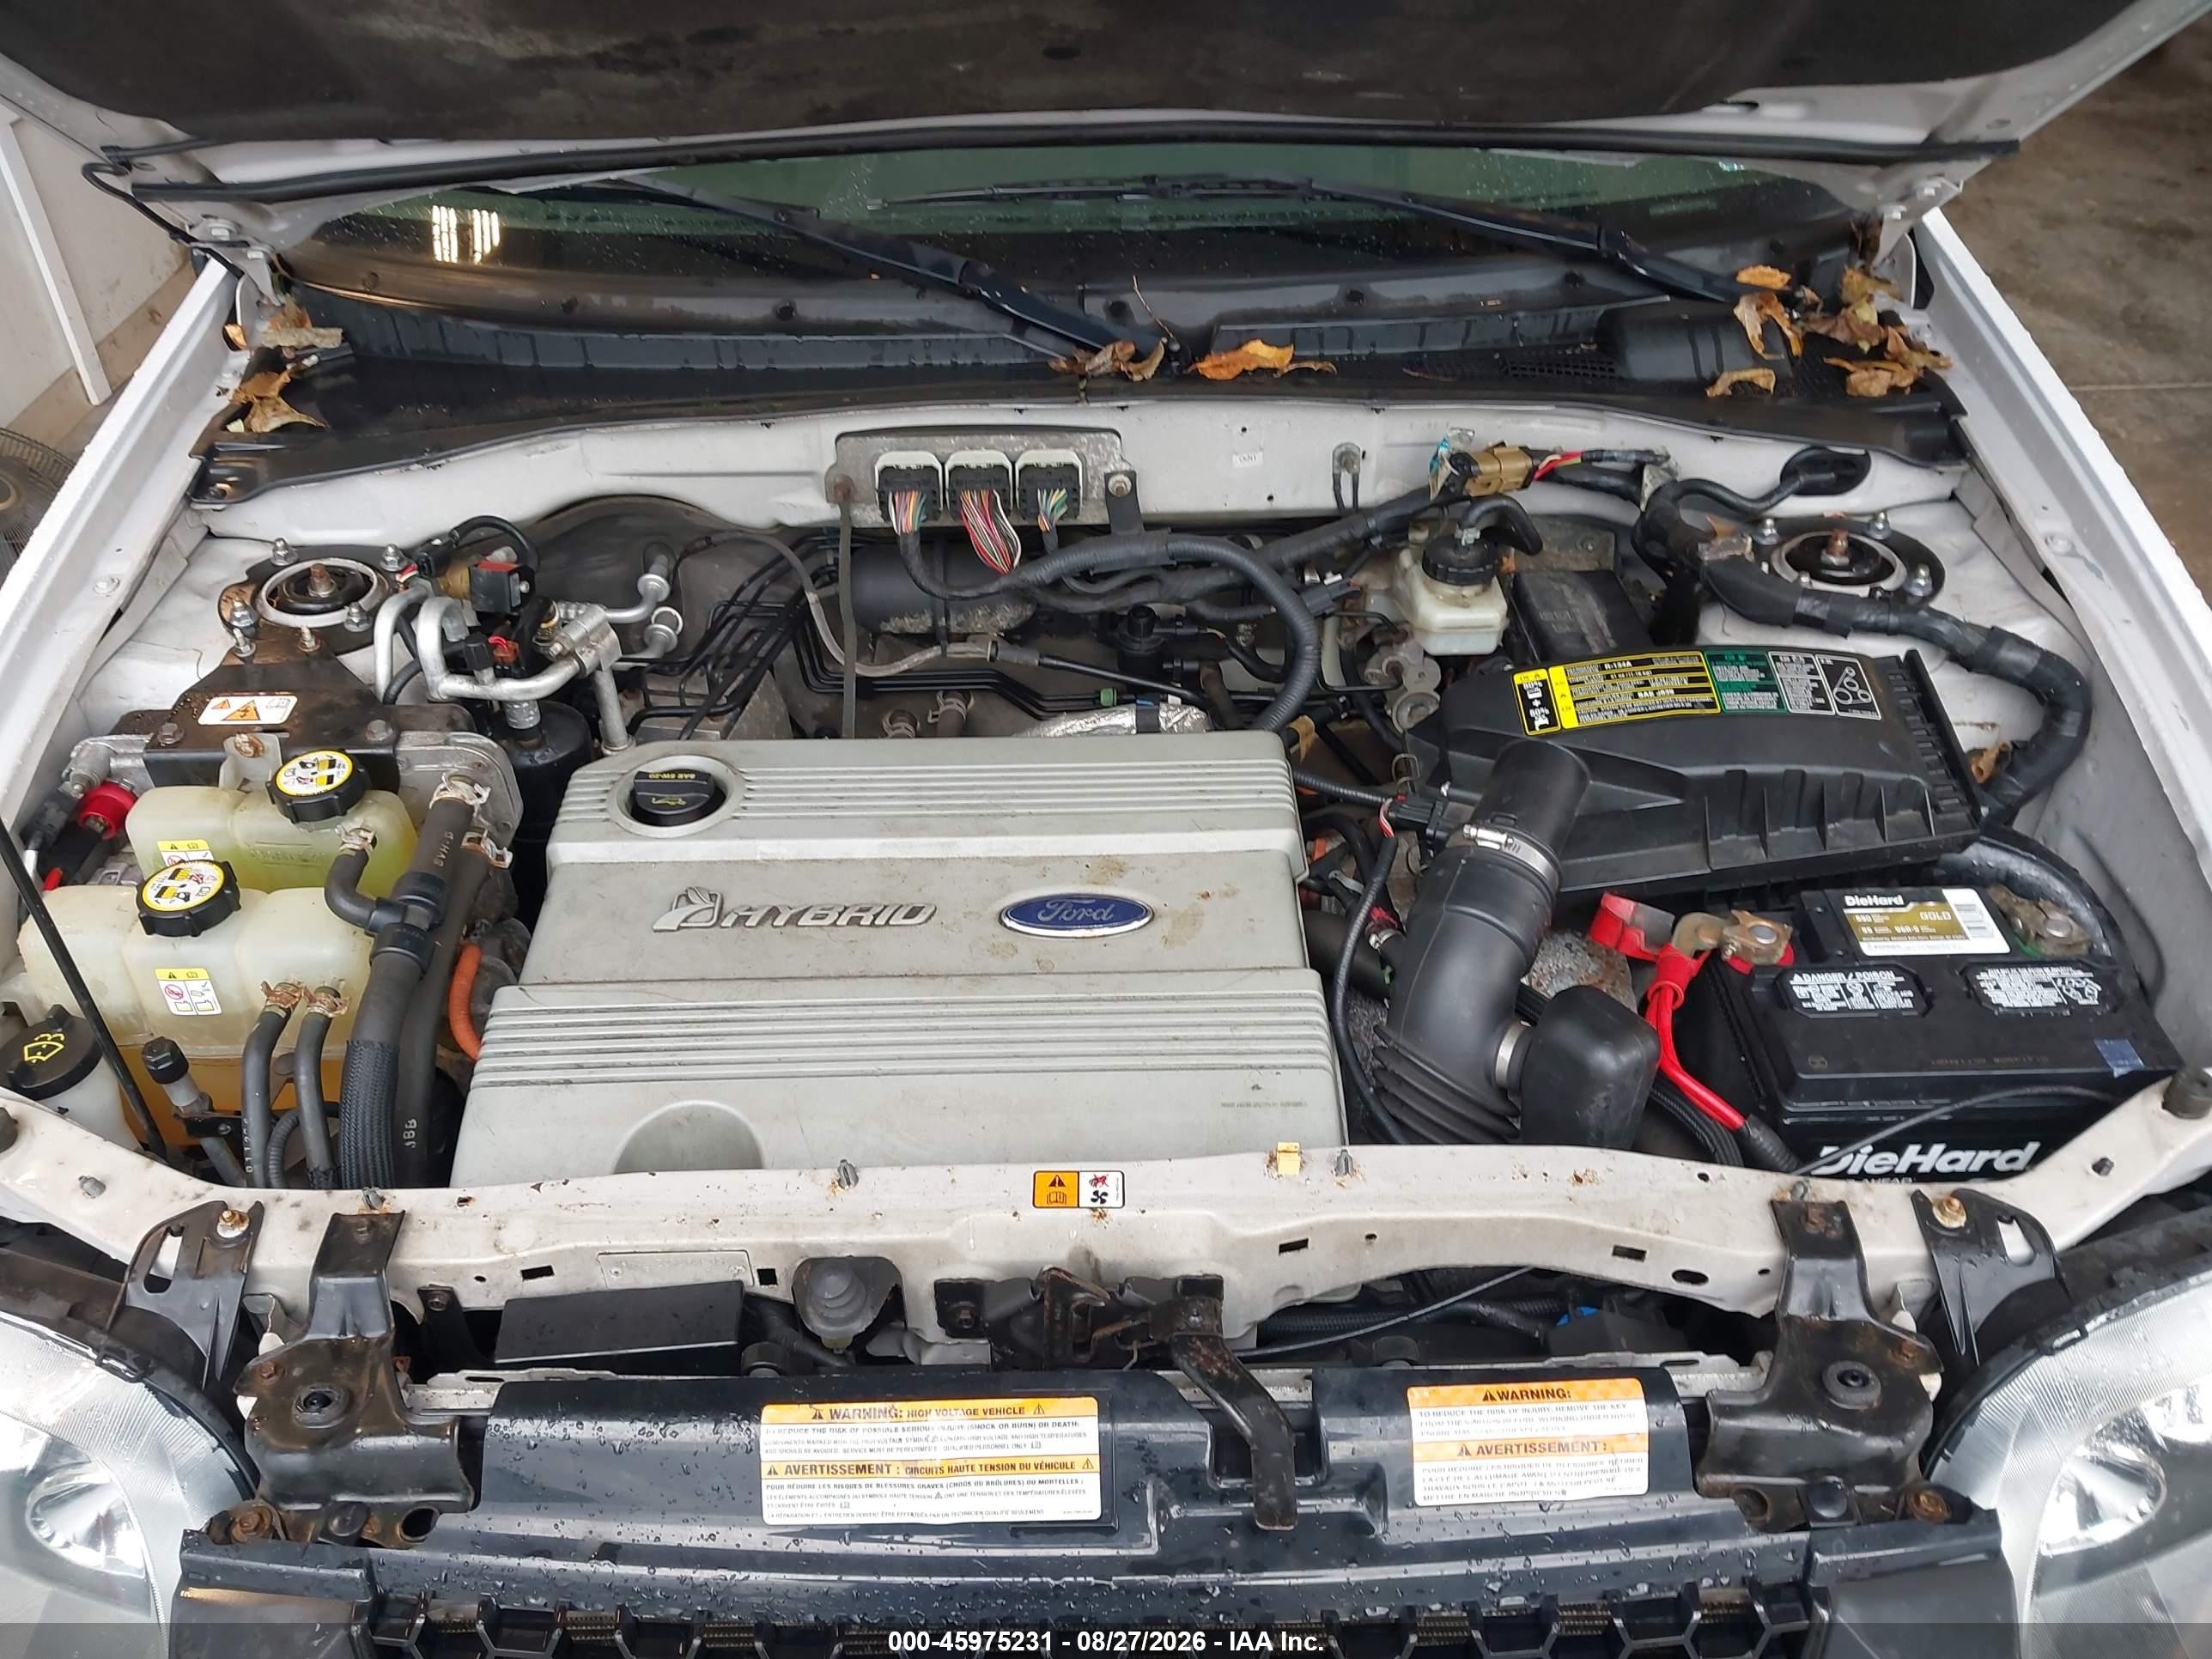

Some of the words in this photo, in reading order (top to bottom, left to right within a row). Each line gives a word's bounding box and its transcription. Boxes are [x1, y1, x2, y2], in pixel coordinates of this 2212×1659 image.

[1844, 894, 1904, 906] DieHard
[721, 902, 937, 928] HYBRID
[1036, 896, 1115, 924] Ford
[1919, 911, 1952, 921] GOLD
[1802, 973, 1846, 981] DANGER
[1855, 970, 1895, 981] POISON
[1811, 1141, 2041, 1176] DieHard
[1497, 1388, 1571, 1401] WARNING:
[830, 1406, 902, 1420] WARNING:
[908, 1407, 931, 1418] HIGH
[937, 1407, 978, 1417] VOLTAGE
[982, 1406, 1025, 1416] VEHICLE
[1476, 1441, 1601, 1455] AVERTISSEMENT
[784, 1462, 892, 1476] AVERTISSEMENT
[905, 1465, 945, 1475] CIRCUITS
[947, 1465, 975, 1474] HAUTE
[979, 1462, 1017, 1473] TENSION
[1019, 1462, 1031, 1471] DU
[1034, 1459, 1076, 1471] VÉHICULE
